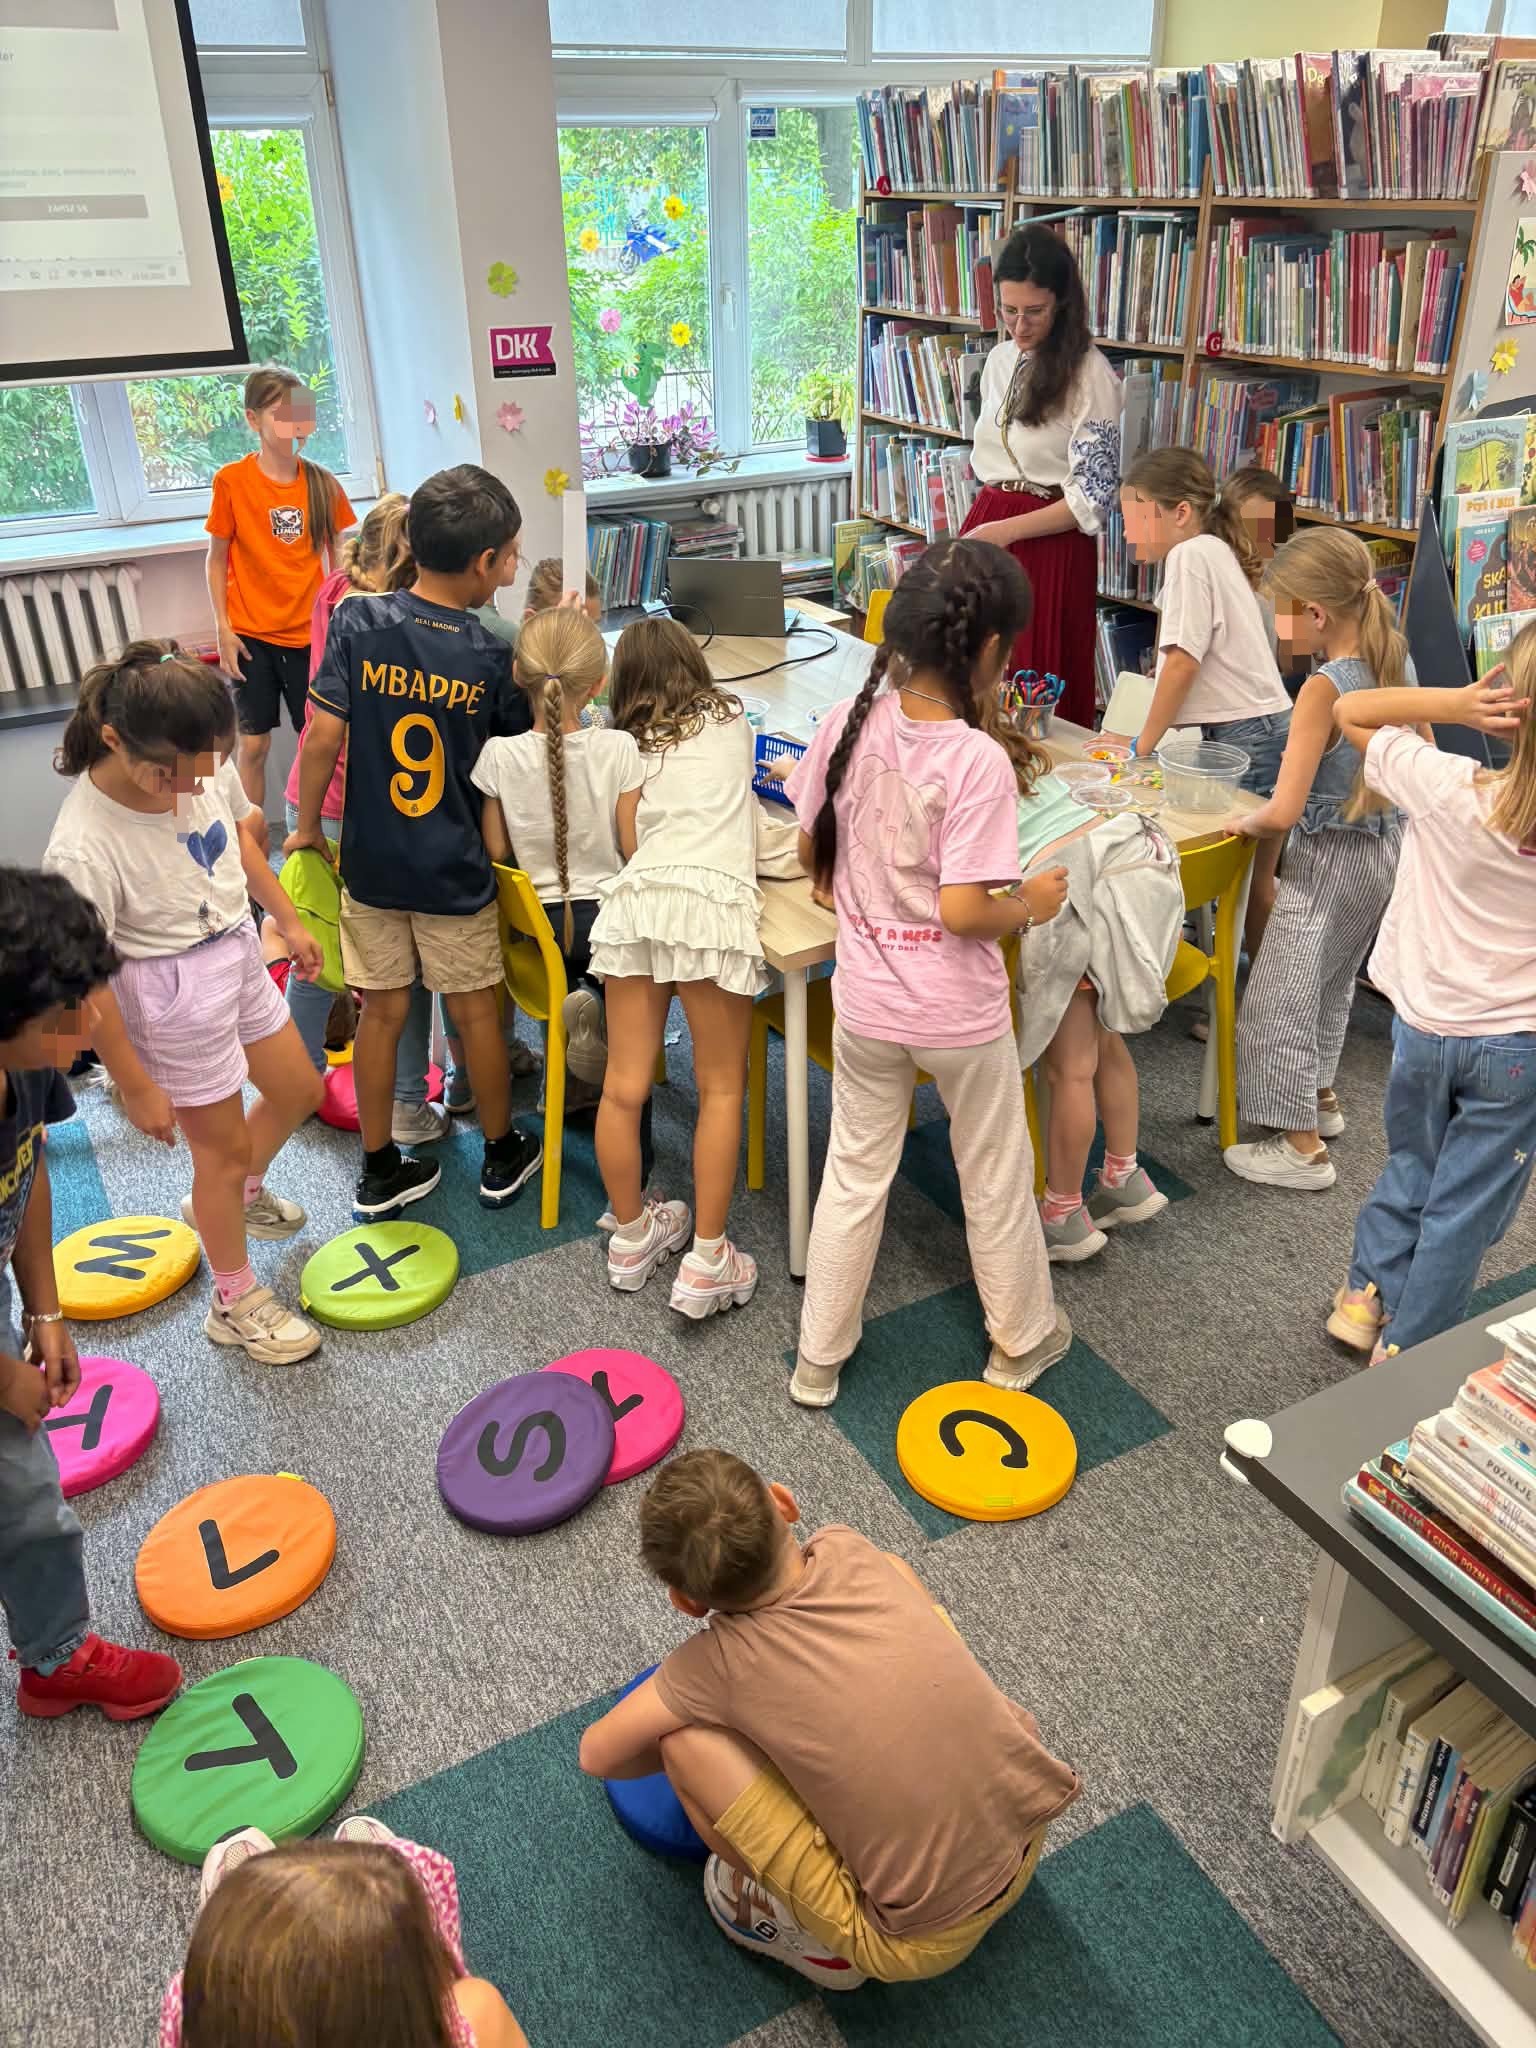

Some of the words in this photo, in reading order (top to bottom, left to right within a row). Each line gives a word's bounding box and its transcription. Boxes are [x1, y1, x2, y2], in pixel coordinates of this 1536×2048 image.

[1210, 336, 1220, 351] G
[415, 617, 431, 626] REAL
[431, 620, 460, 633] MADRID
[361, 660, 487, 715] MBAPPÉ
[390, 713, 445, 817] 9
[887, 929, 897, 940] A
[902, 928, 943, 942] MESS
[331, 1242, 421, 1292] X
[477, 1410, 567, 1482] S
[939, 1409, 1029, 1469] C
[198, 1519, 280, 1589] L
